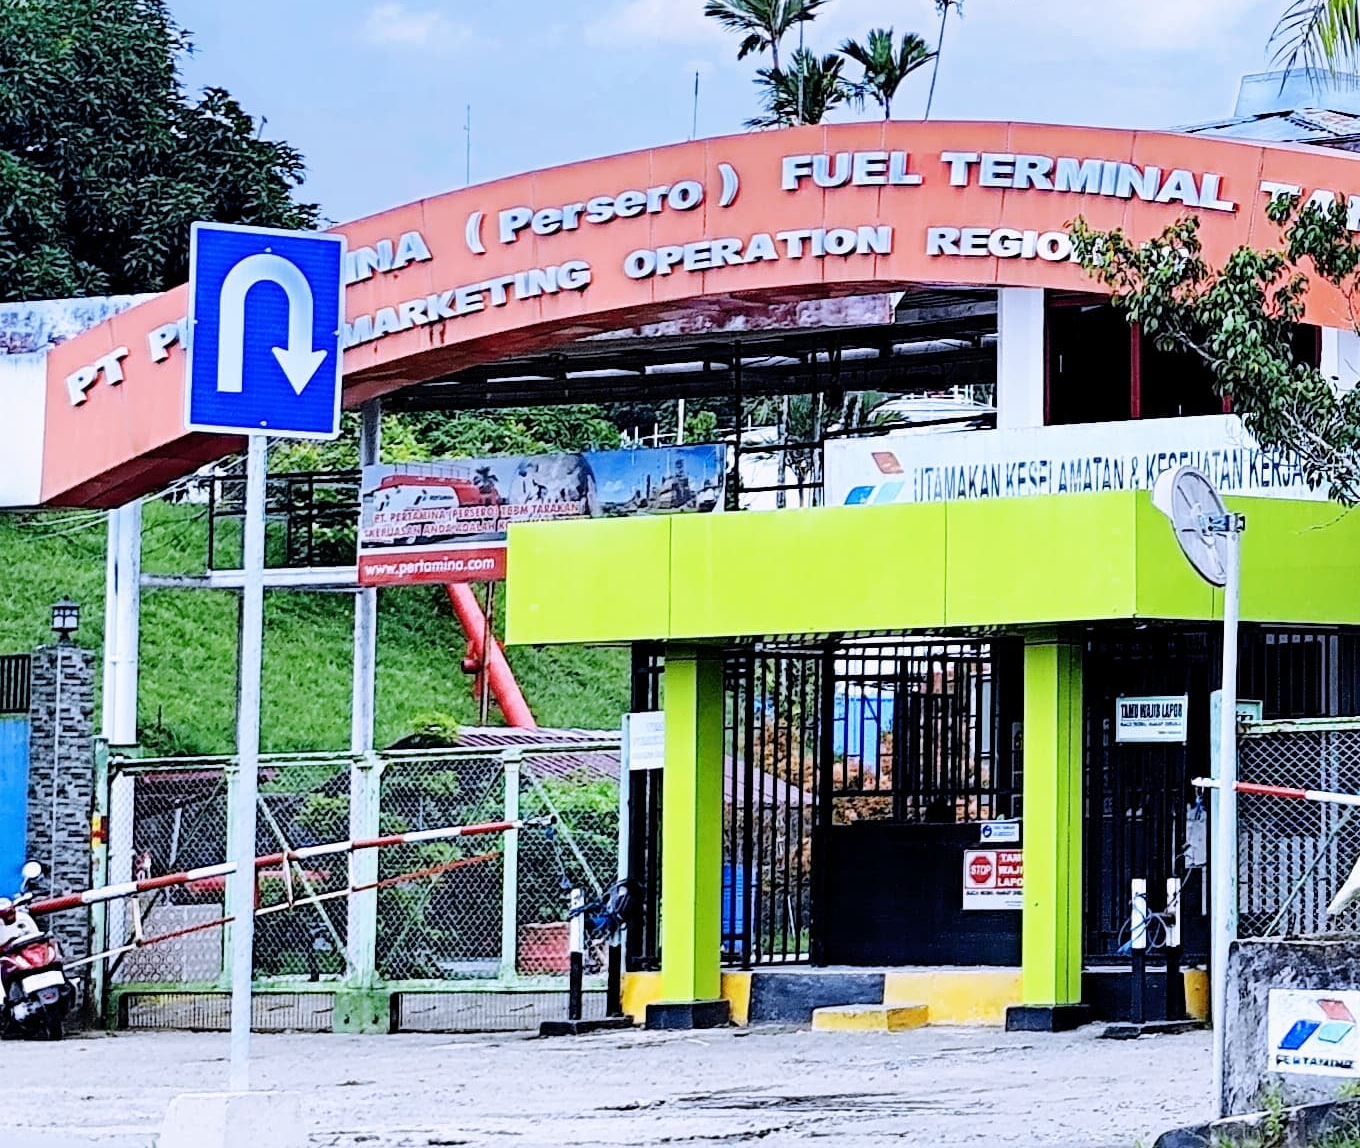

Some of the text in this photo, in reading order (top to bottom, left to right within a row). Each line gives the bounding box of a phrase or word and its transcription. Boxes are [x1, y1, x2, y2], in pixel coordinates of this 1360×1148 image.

[65, 346, 129, 406] PT
[782, 152, 922, 190] FUEL
[942, 152, 1236, 212] TERMINAL
[343, 260, 592, 352] MARKETING
[624, 226, 893, 280] OPERATION
[914, 463, 1000, 502] UTAMAKAN
[1130, 456, 1139, 490] &
[365, 556, 494, 578] www.pertamina.com
[970, 864, 992, 875] STOP
